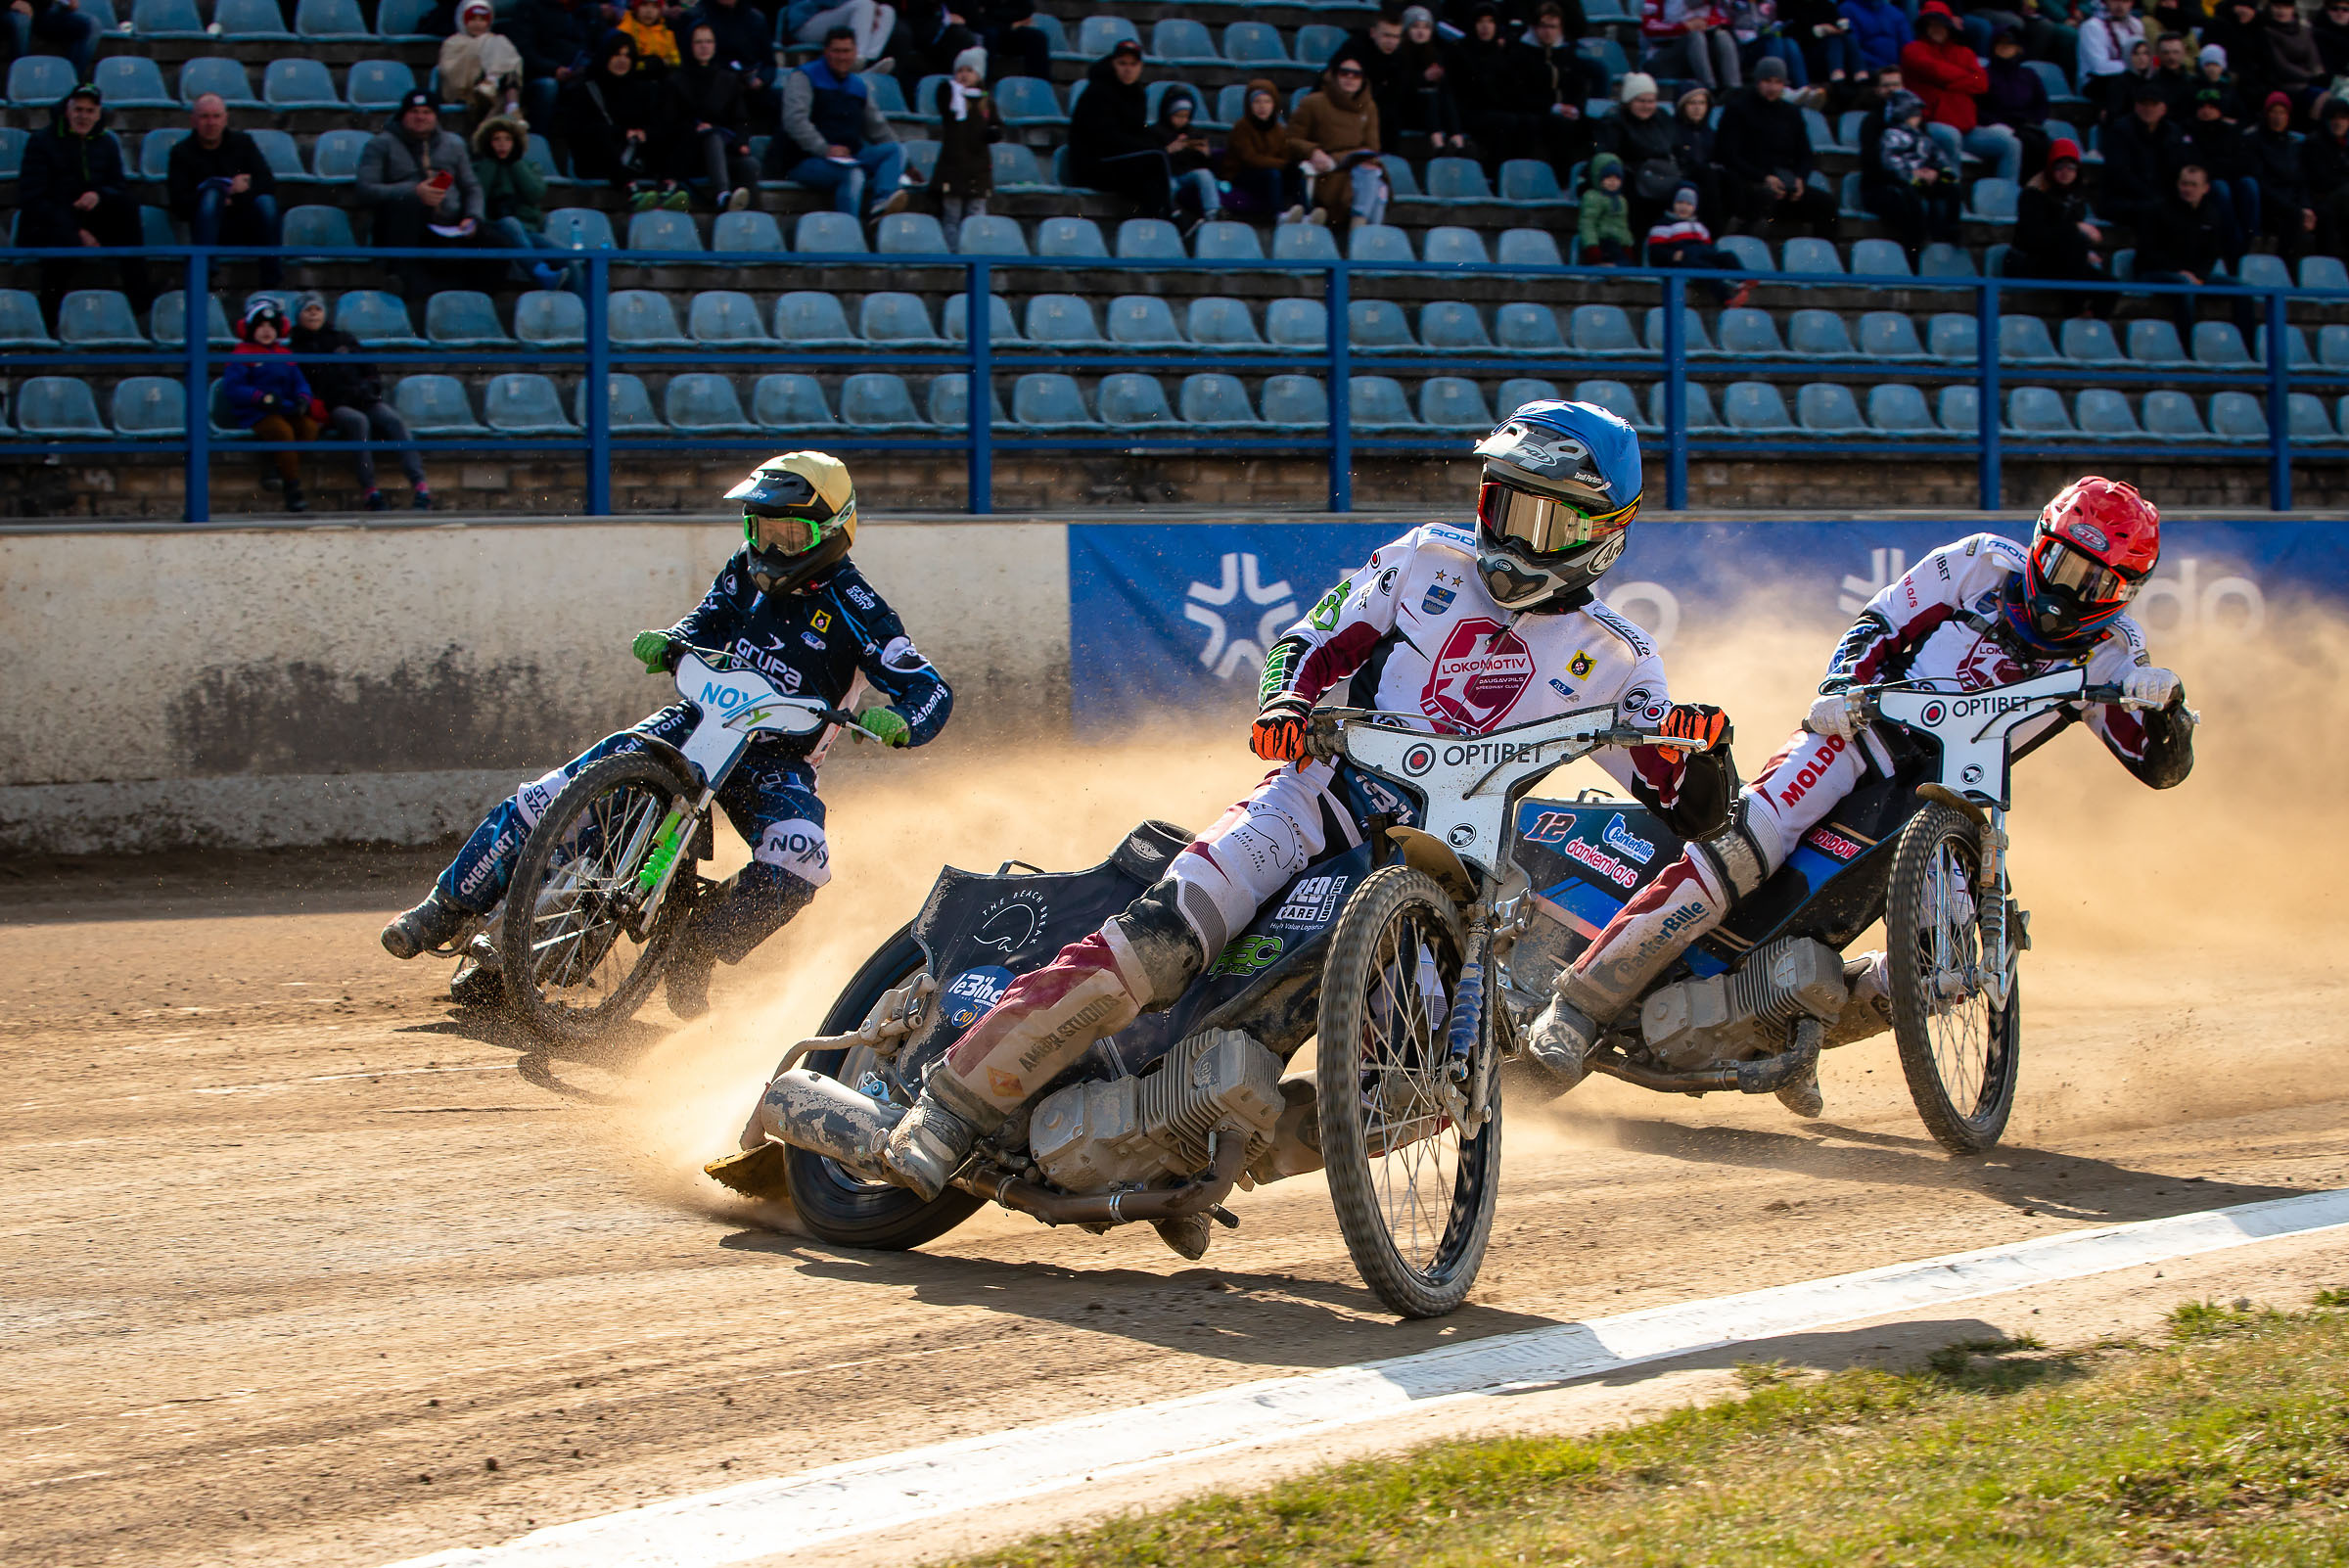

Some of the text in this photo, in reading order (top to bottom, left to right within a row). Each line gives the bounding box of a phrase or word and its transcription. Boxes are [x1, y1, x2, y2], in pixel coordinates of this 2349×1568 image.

[1442, 657, 1527, 675] LOKOMOTIV
[1952, 696, 2032, 719] OPTIBET
[1443, 742, 1545, 767] OPTIBET
[1523, 810, 1577, 844] 12
[1610, 827, 1654, 858] BarkerBille
[460, 830, 515, 895] CHEMART
[1565, 836, 1618, 877] dankemi
[1611, 864, 1638, 889] a/s
[1284, 876, 1332, 904] RED
[982, 889, 1048, 945] THE BEACH BREAK
[1618, 900, 1707, 975] BarkerBille
[953, 1008, 974, 1023] C10
